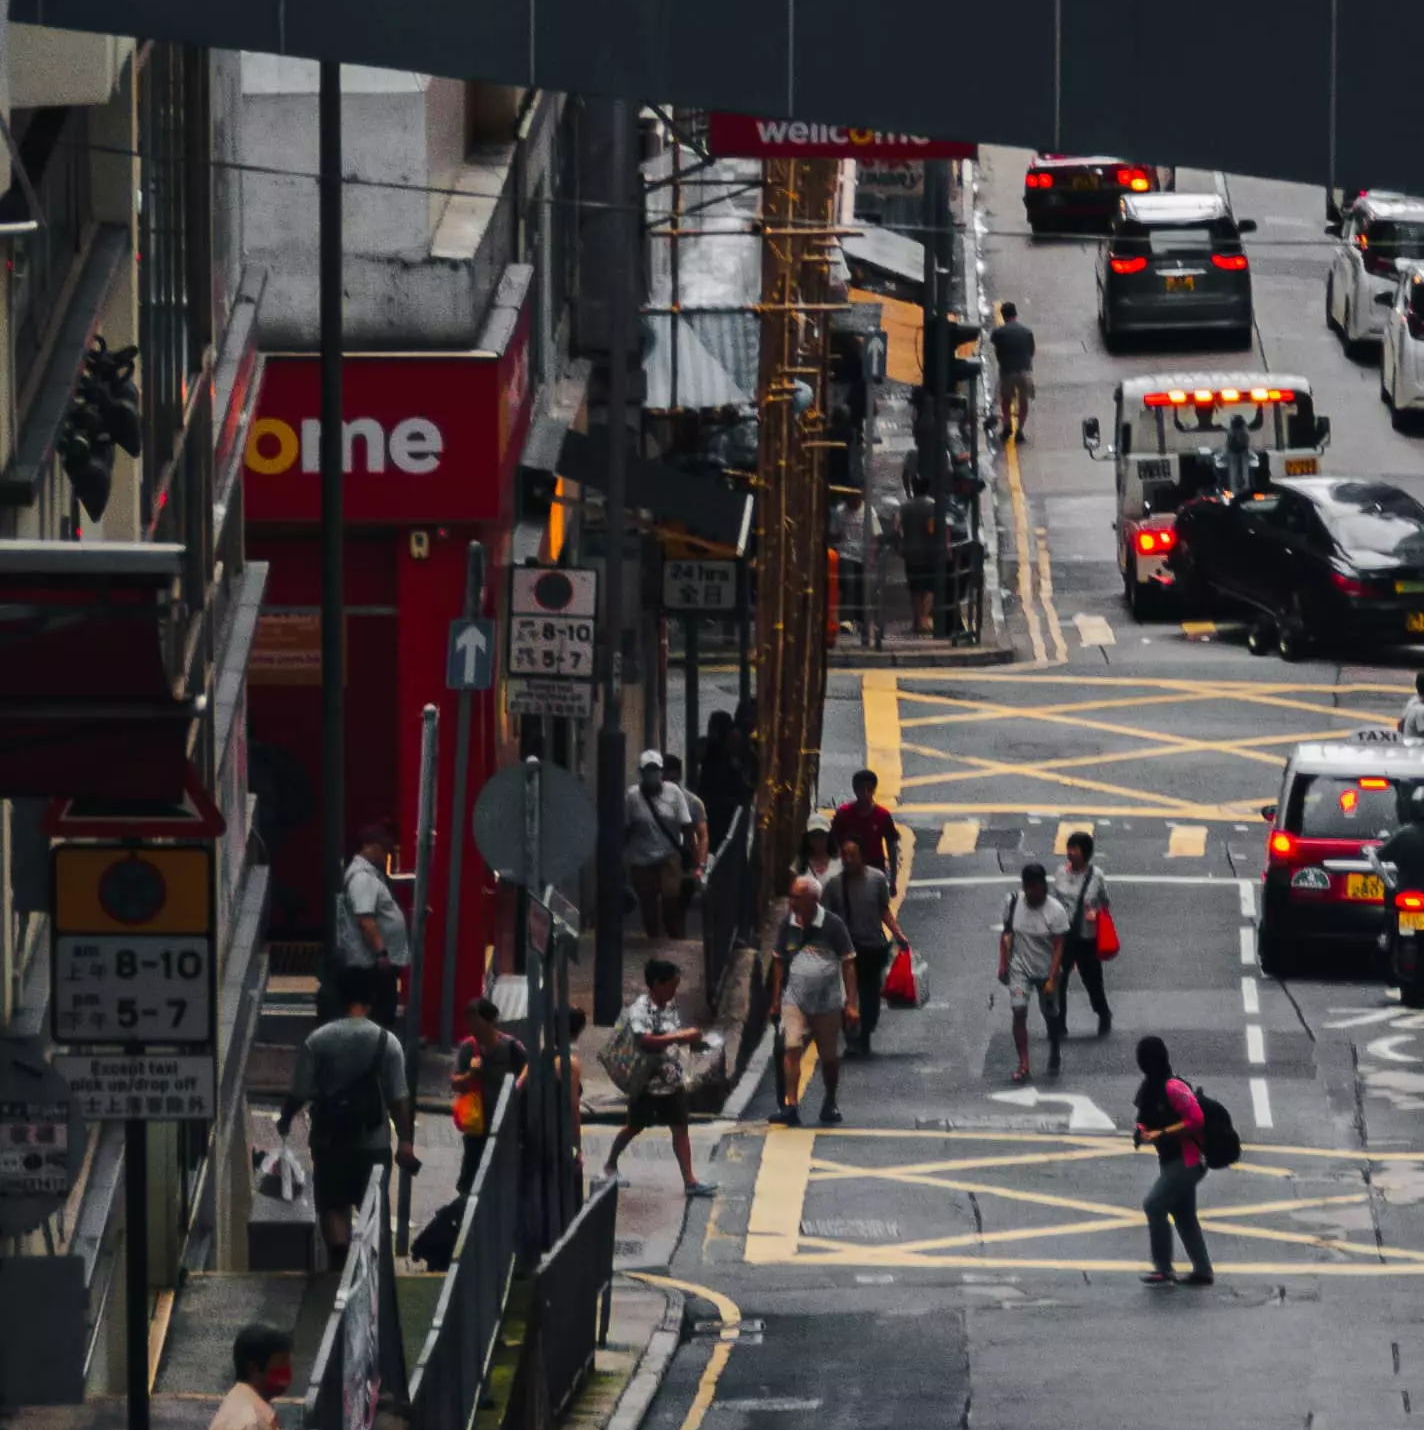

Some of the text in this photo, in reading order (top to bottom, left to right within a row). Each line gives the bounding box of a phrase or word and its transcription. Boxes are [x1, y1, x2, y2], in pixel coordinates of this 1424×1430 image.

[670, 562, 693, 579] 24
[543, 622, 591, 641] 8-10
[543, 650, 581, 669] 5-7
[1358, 730, 1397, 742] TAXI
[73, 946, 99, 957] am
[64, 962, 108, 981] 上午
[116, 949, 202, 980] 8-10
[72, 993, 100, 1008] pm
[117, 998, 187, 1028] 5-7
[91, 1060, 177, 1076] Except taxi
[71, 1077, 197, 1093] pick up/drop off
